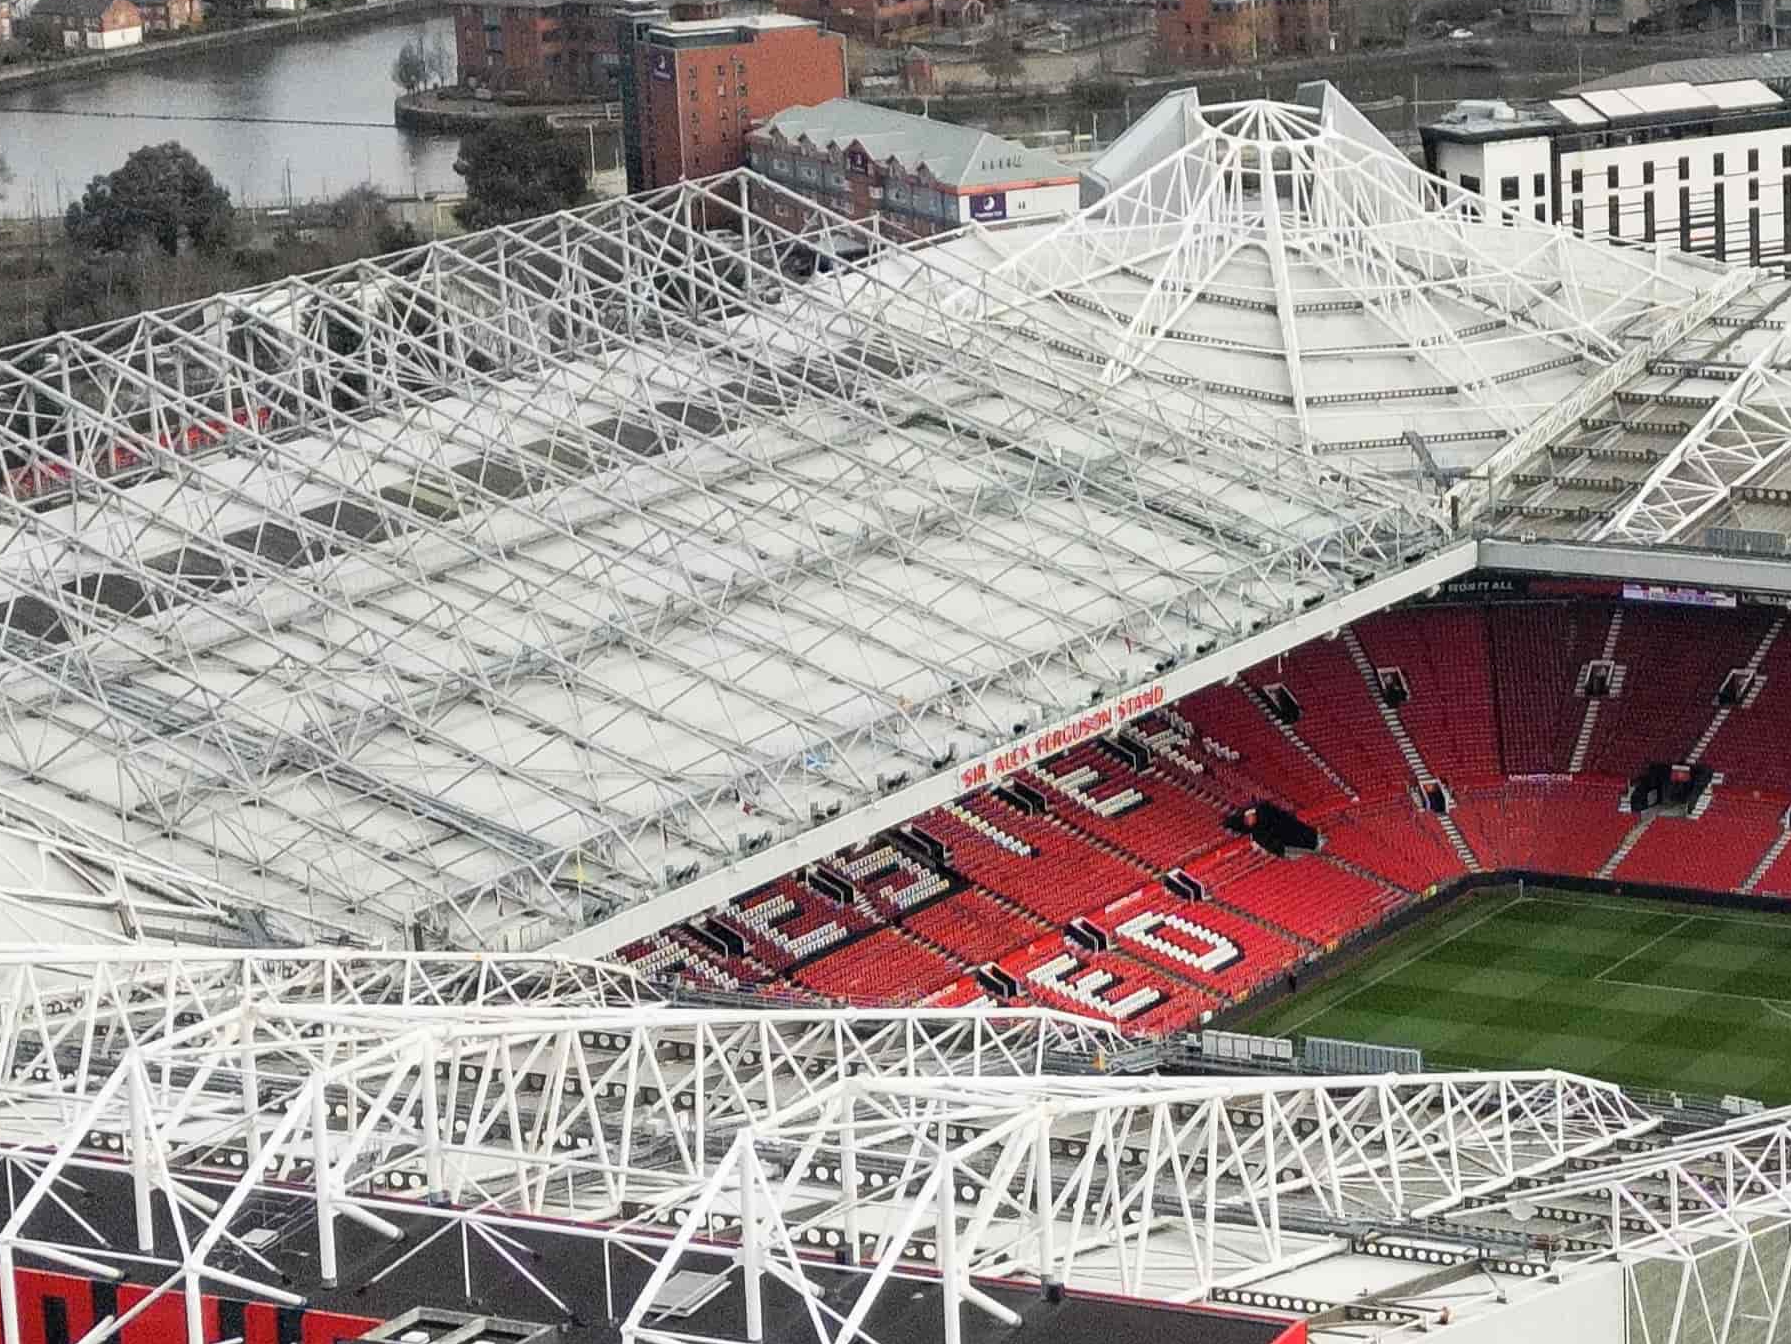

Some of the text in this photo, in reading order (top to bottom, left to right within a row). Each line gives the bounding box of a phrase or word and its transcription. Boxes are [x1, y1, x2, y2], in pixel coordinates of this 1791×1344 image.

[961, 762, 987, 788] SIR
[1035, 707, 1112, 756] FERGUSON
[1117, 685, 1165, 720] STAND
